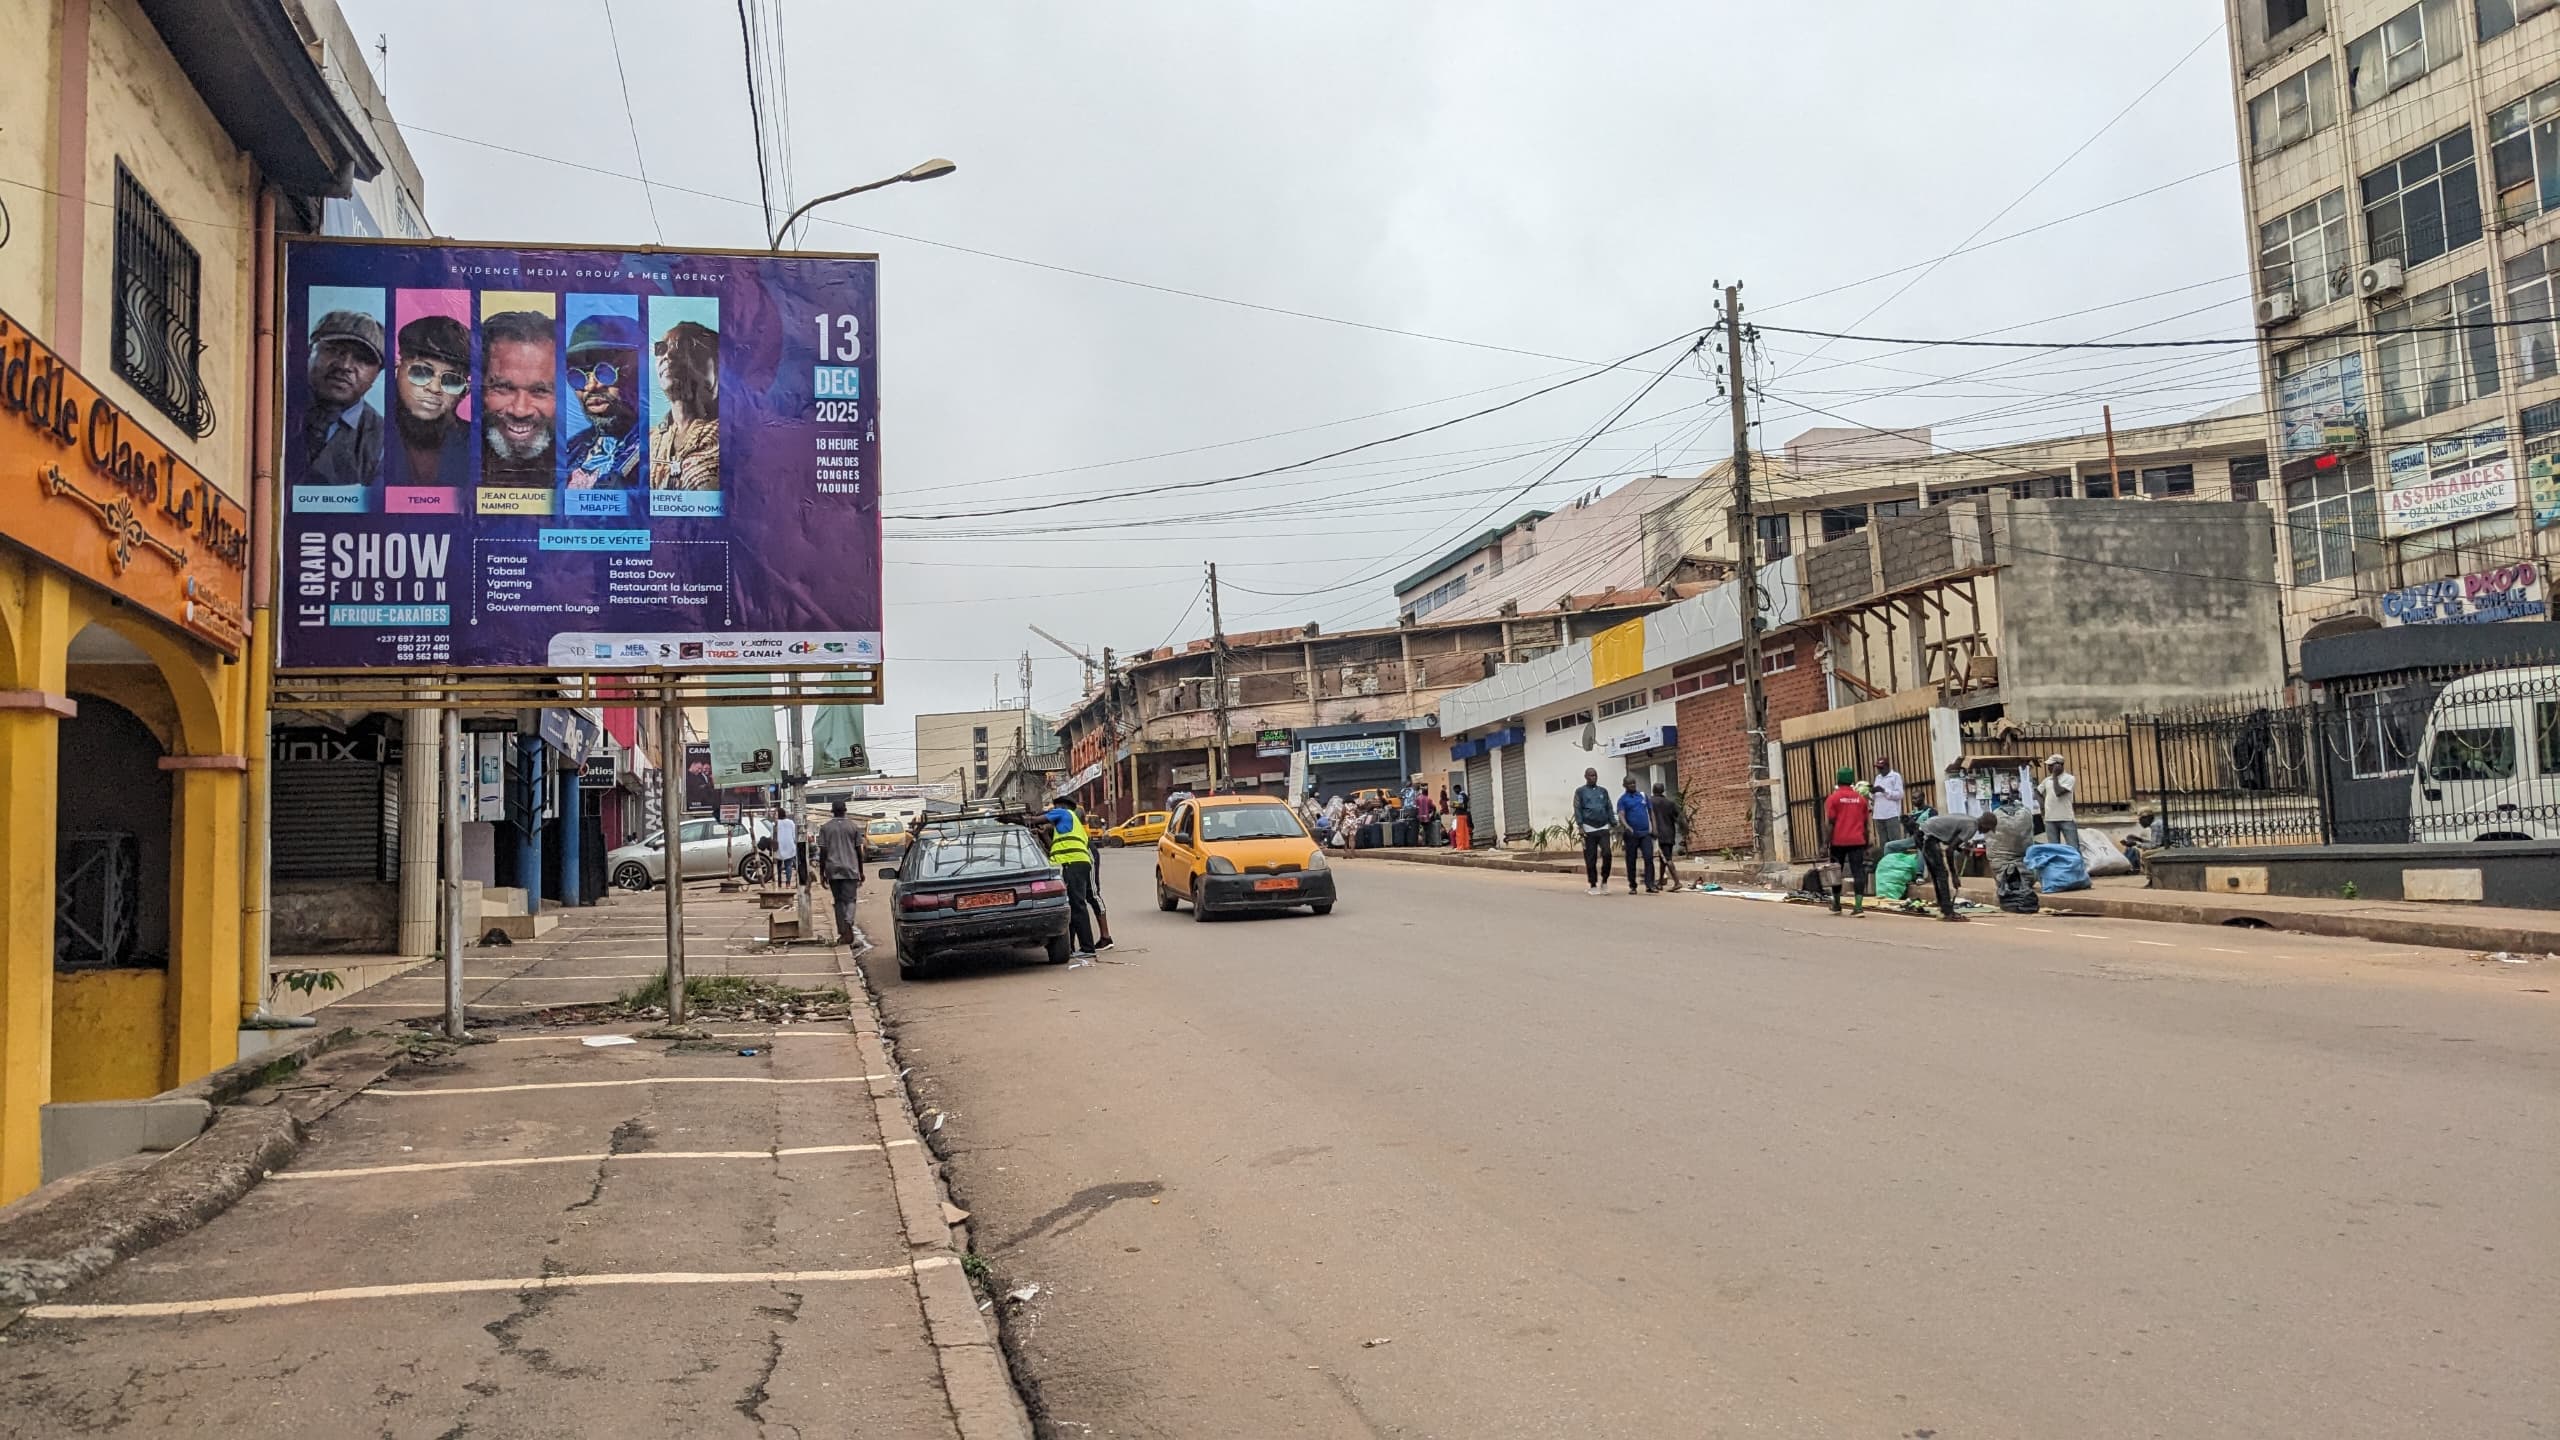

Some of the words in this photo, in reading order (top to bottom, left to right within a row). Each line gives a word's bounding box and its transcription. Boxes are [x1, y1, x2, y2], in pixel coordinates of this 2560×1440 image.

[451, 266, 519, 276] EVIDENCE
[527, 268, 568, 277] MEDIA
[576, 270, 620, 279] GROUP
[628, 271, 635, 279] &
[642, 272, 668, 280] MEB
[675, 273, 726, 282] AGENCY
[815, 313, 861, 362] 13
[816, 367, 857, 396] DEC
[815, 401, 859, 422] 2025
[816, 438, 826, 450] 18
[828, 438, 859, 450] HEURE
[2432, 439, 2463, 458] SOLUTION
[816, 456, 843, 467] PALAIS
[844, 457, 859, 467] DES
[816, 470, 860, 480] CONGRES
[88, 397, 158, 503] Class
[163, 452, 194, 530] Le
[198, 481, 248, 570] Must
[816, 483, 860, 493] YAOUNDE
[2392, 464, 2505, 511] ASSURANCES
[298, 495, 320, 504] GUY
[322, 495, 359, 504] BILONG
[408, 495, 441, 504] TENOR
[481, 493, 505, 501] JEAN
[508, 492, 547, 501] CLAUDE
[578, 493, 620, 502] ETIENNE
[652, 491, 684, 503] HERVÉ
[2450, 484, 2505, 508] INSURANCE
[481, 502, 520, 511] NAIMRO
[580, 503, 621, 512] MBAPPE
[652, 504, 695, 513] LEBONGO
[547, 535, 588, 545] POINTS
[590, 536, 605, 545] DE
[608, 536, 644, 545] VENTE
[331, 532, 451, 579] SHOW
[487, 554, 528, 565] Famous
[299, 531, 327, 596] GRAND
[609, 557, 623, 566] Le
[625, 557, 653, 567] kawa
[609, 569, 646, 579] Bastos
[648, 570, 676, 579] Dovv
[486, 579, 532, 590] Vgaming
[609, 582, 668, 592] Restaurant
[670, 582, 680, 592] la
[682, 583, 723, 592] Karisma
[331, 581, 447, 601] FUSION
[486, 591, 521, 602] Playce
[609, 595, 668, 605] Restaurant
[332, 606, 447, 623] AFRIQUE-CARAÏBES
[486, 603, 563, 613] Gouvernement
[565, 603, 600, 615] lounge
[299, 604, 325, 627] LE
[376, 635, 396, 643] +237
[397, 635, 414, 643] 697
[415, 635, 431, 643] 231
[434, 634, 450, 642] 001
[432, 643, 450, 651] 480
[397, 653, 414, 661] 659
[415, 652, 431, 660] 562
[742, 649, 783, 658] CANAL+
[271, 733, 358, 761] inix
[1311, 743, 1337, 752] CAVE
